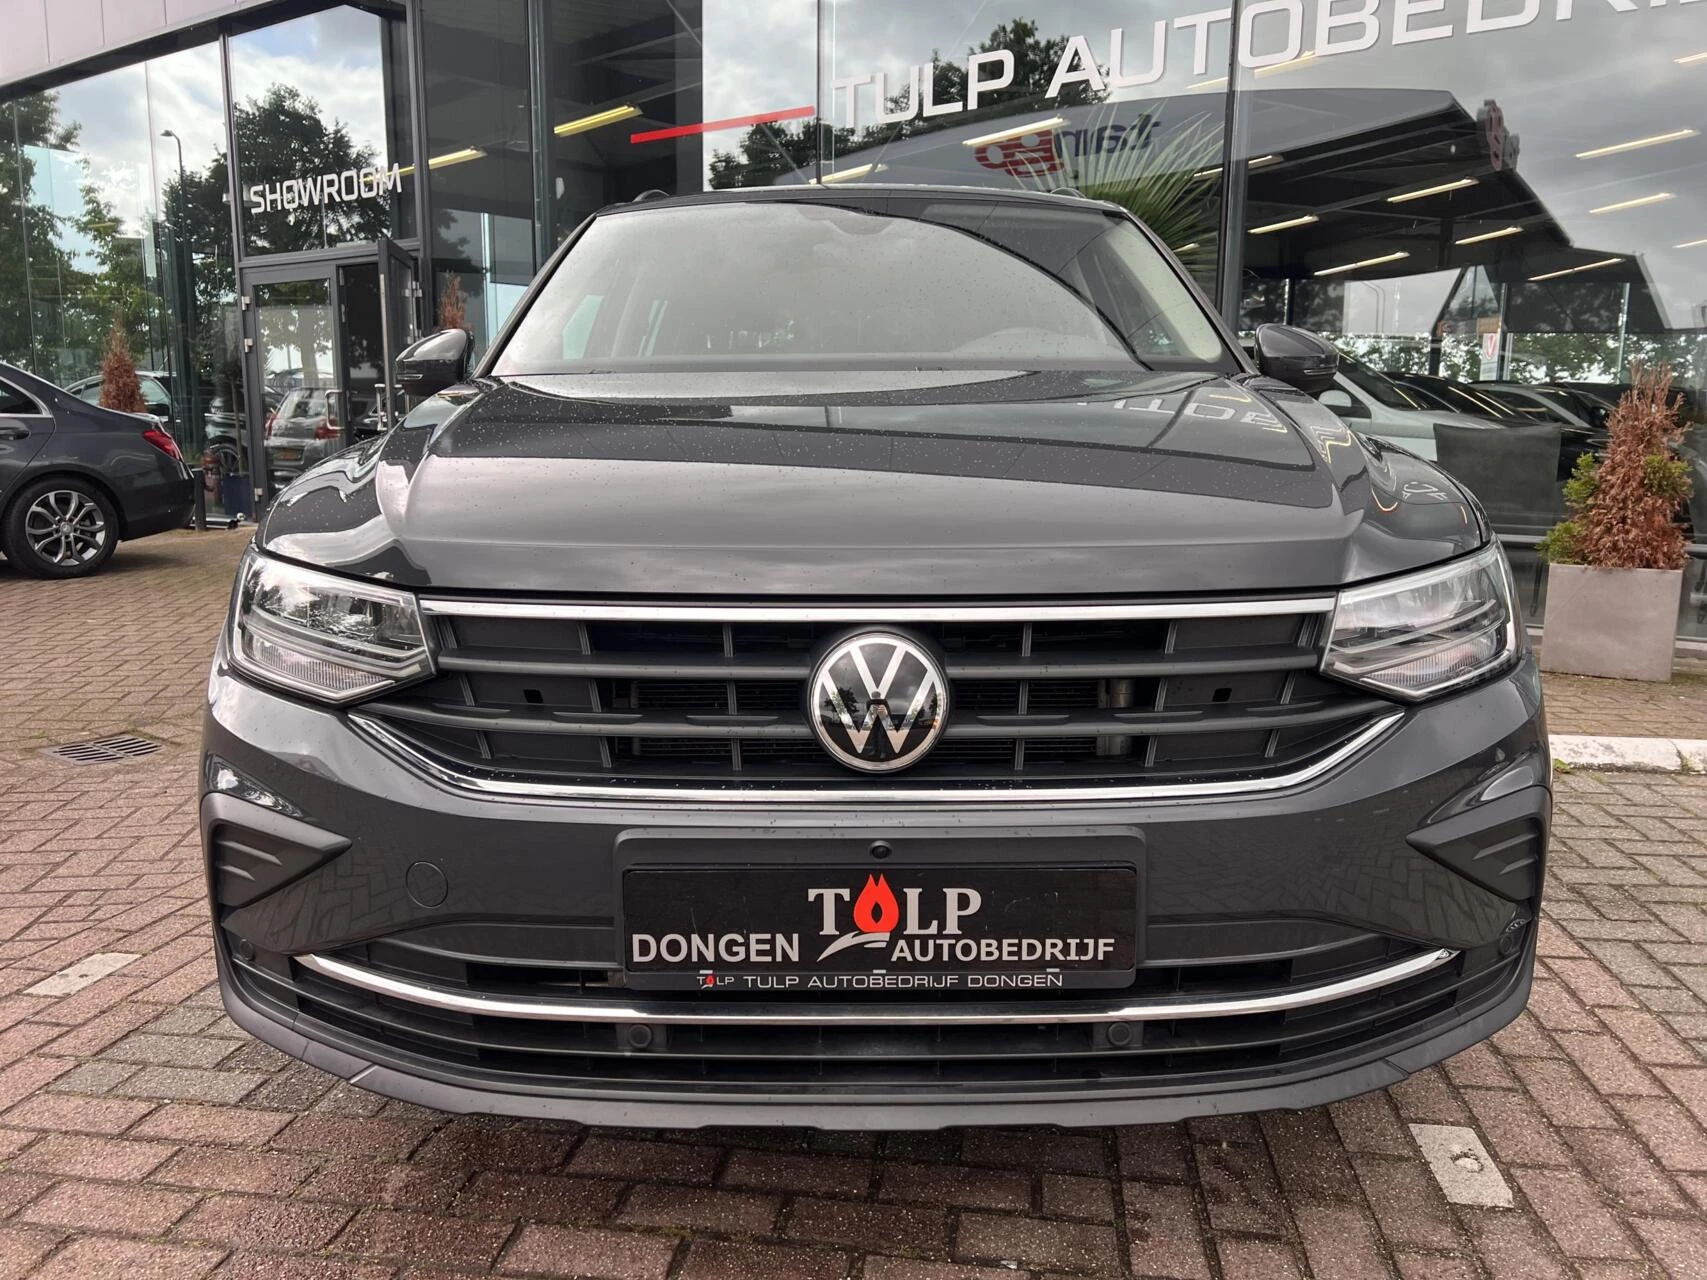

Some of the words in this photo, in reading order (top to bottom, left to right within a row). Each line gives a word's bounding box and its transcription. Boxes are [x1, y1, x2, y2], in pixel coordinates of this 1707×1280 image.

[831, 49, 1014, 128] TULP
[1044, 0, 1707, 99] AUTOBE
[249, 162, 402, 214] SHOWROOM
[631, 933, 800, 963] DONGEN
[890, 937, 1115, 963] AUTOBEDRIJF
[743, 975, 800, 989] TULP
[807, 974, 960, 989] AUTOBEDRIJF
[967, 973, 1064, 988] DONGEN
